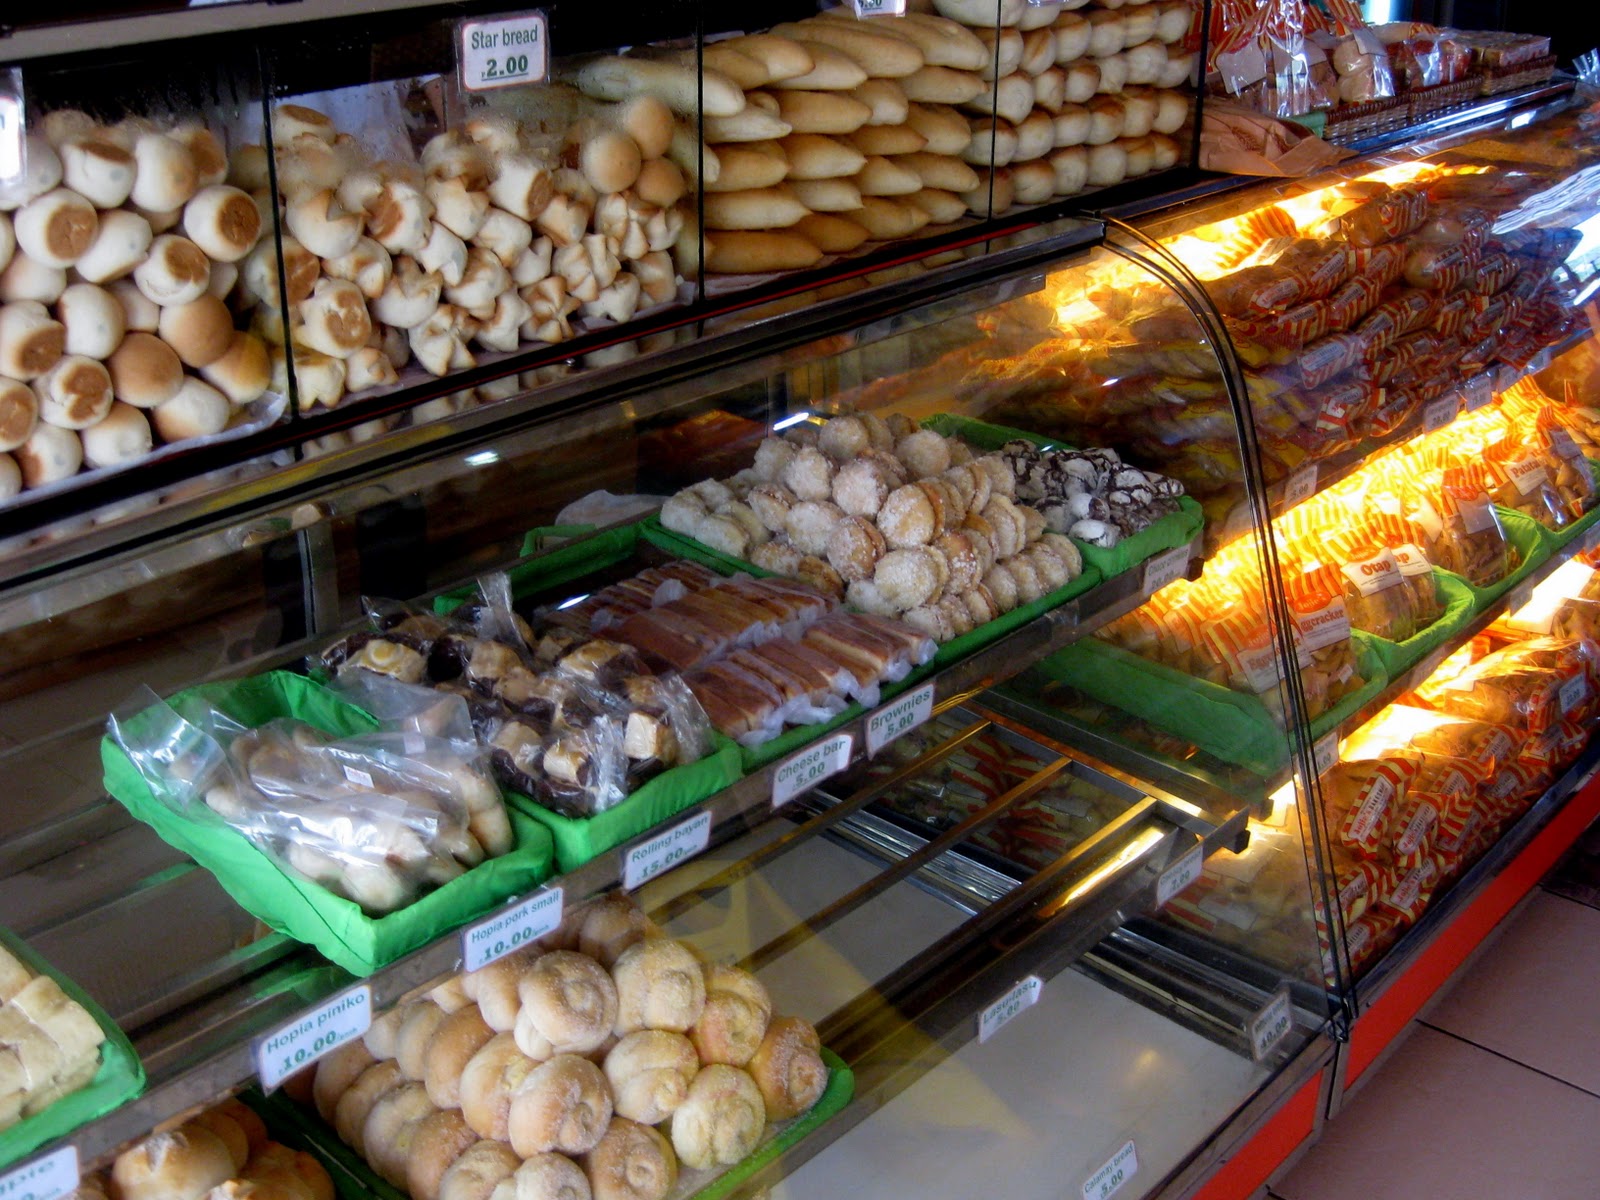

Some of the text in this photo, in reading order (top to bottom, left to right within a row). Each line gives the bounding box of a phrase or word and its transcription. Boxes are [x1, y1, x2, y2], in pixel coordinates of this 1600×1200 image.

[472, 24, 538, 50] Star bread
[1360, 560, 1391, 576] Otap
[871, 691, 930, 732] Brownies
[778, 741, 846, 783] Cheese bar
[632, 836, 672, 862] Rolling
[471, 890, 560, 943] Hopia pork small
[267, 1021, 313, 1054] Hopia
[317, 993, 365, 1027] piniko
[1113, 1143, 1133, 1167] bread
